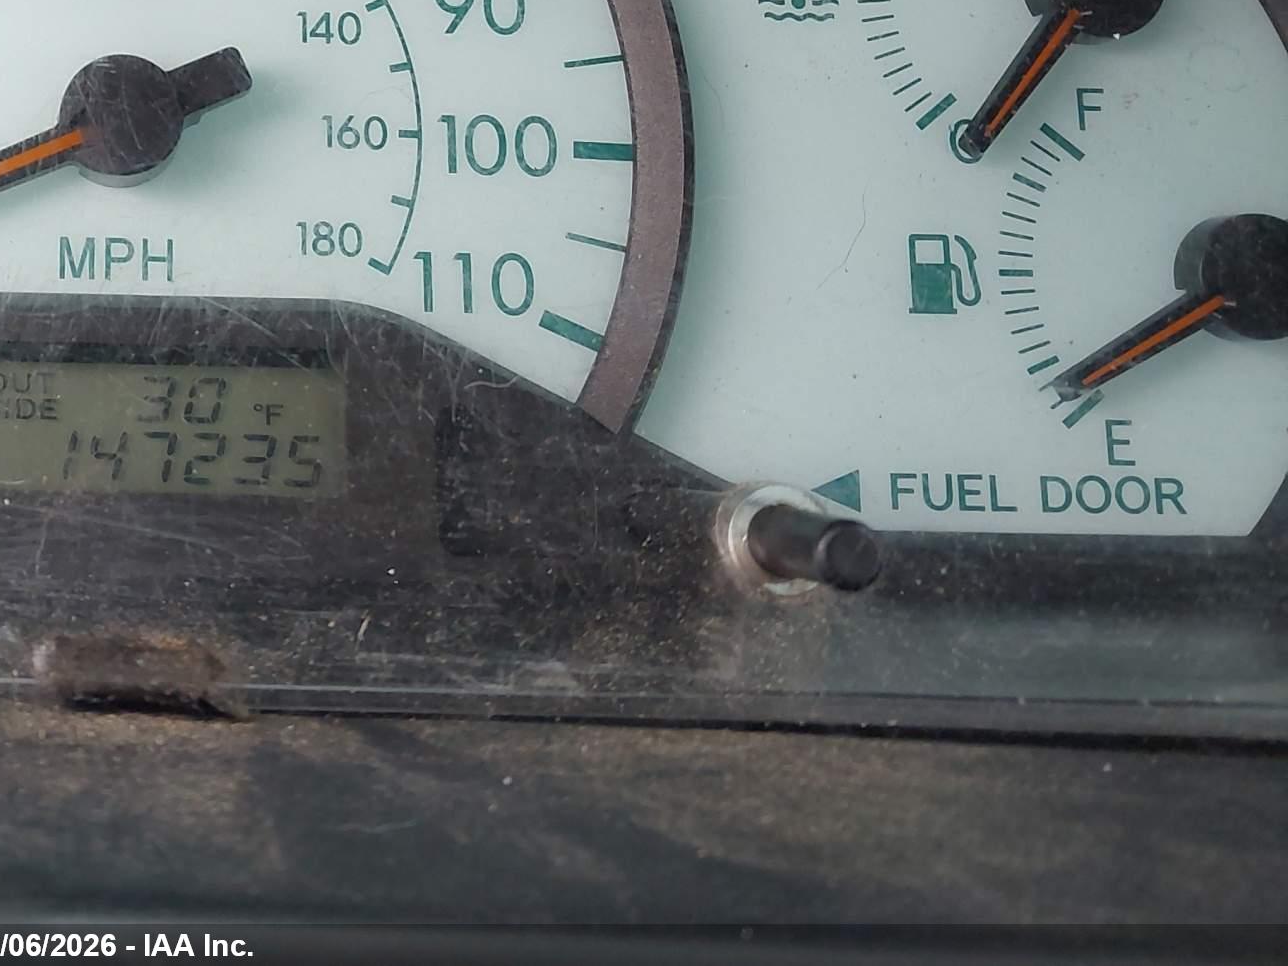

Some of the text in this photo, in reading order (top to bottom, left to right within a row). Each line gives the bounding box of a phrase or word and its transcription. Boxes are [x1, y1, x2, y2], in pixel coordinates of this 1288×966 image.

[296, 11, 362, 46] 140
[321, 115, 389, 151] 160
[1076, 88, 1104, 131] F
[436, 114, 557, 177] 100
[57, 235, 174, 283] MPH
[296, 221, 363, 258] 180
[412, 251, 535, 317] 110
[135, 376, 227, 424] 30
[63, 431, 322, 488] 147235
[1104, 419, 1137, 467] E
[889, 472, 1187, 515] FUEL DOOR
